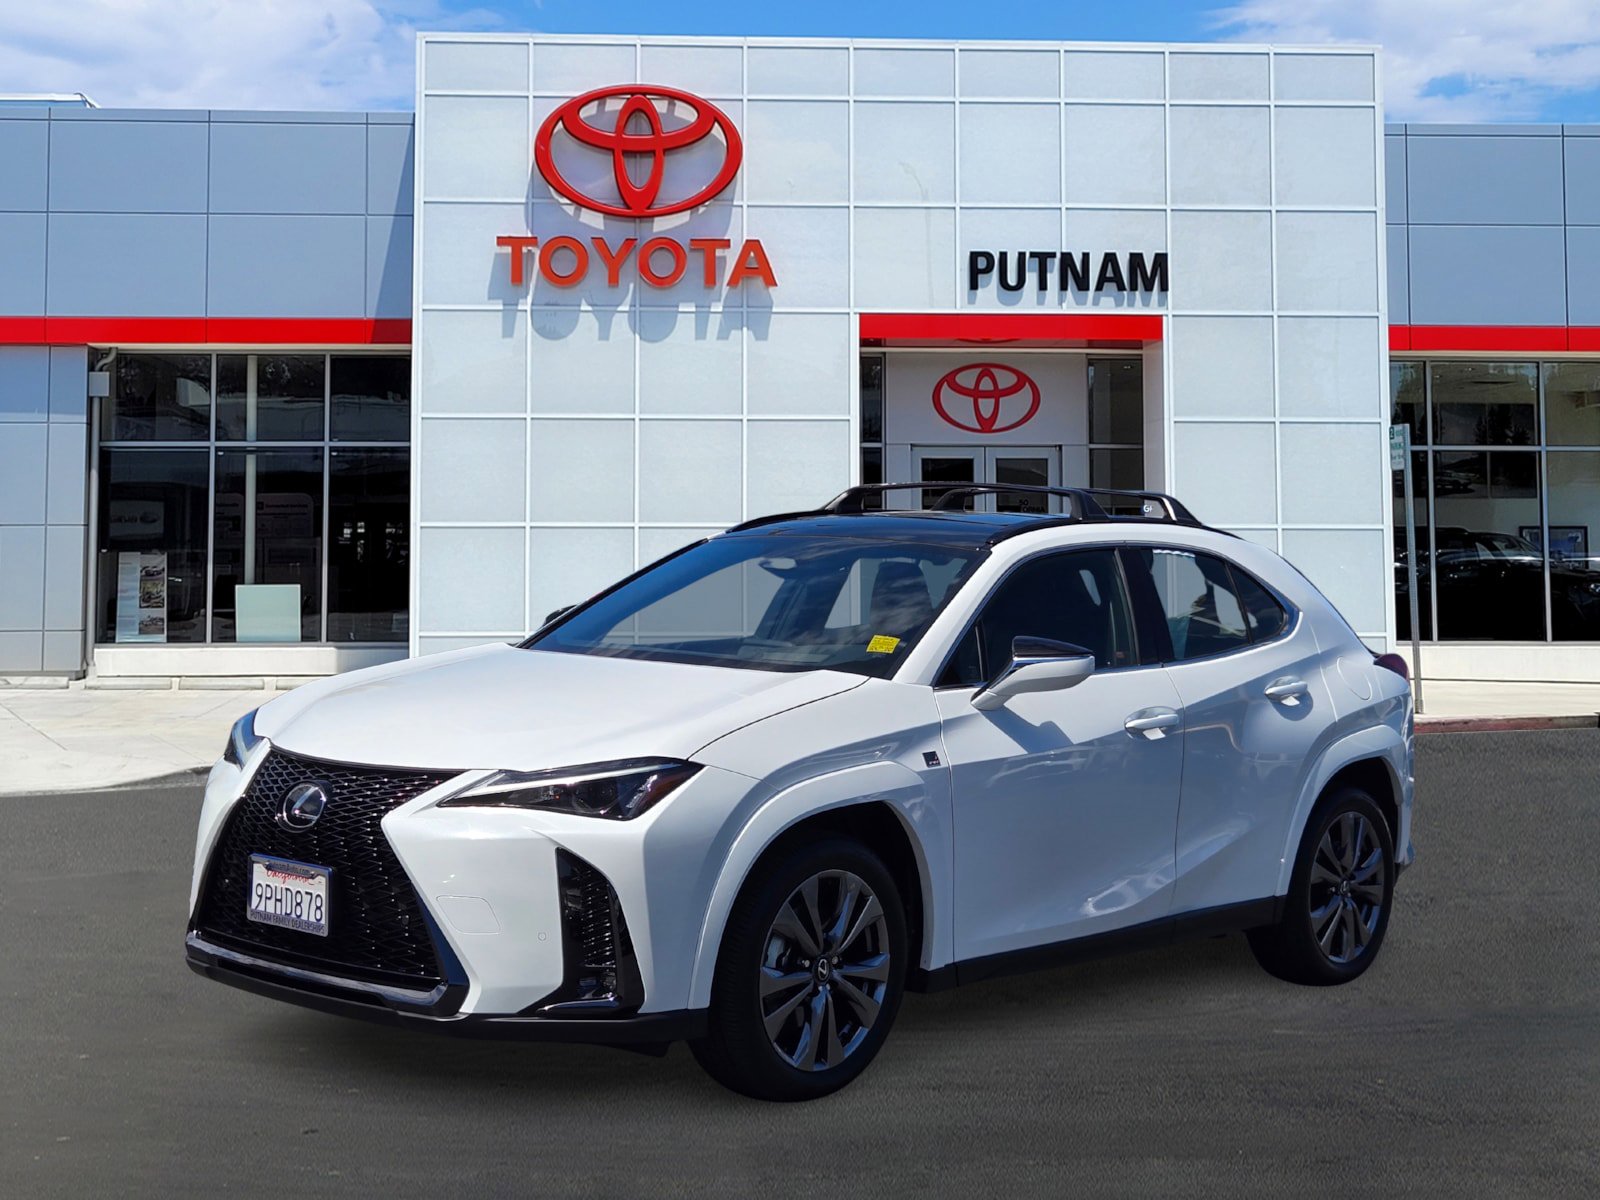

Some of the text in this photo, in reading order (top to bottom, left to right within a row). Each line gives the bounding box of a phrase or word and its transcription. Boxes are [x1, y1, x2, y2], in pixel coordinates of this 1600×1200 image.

[496, 236, 778, 288] TOYOTA
[970, 251, 1168, 292] PUTNAM
[250, 909, 272, 921] PUTNAM
[273, 914, 291, 927] FAMILY
[255, 882, 323, 922] 9PHD878
